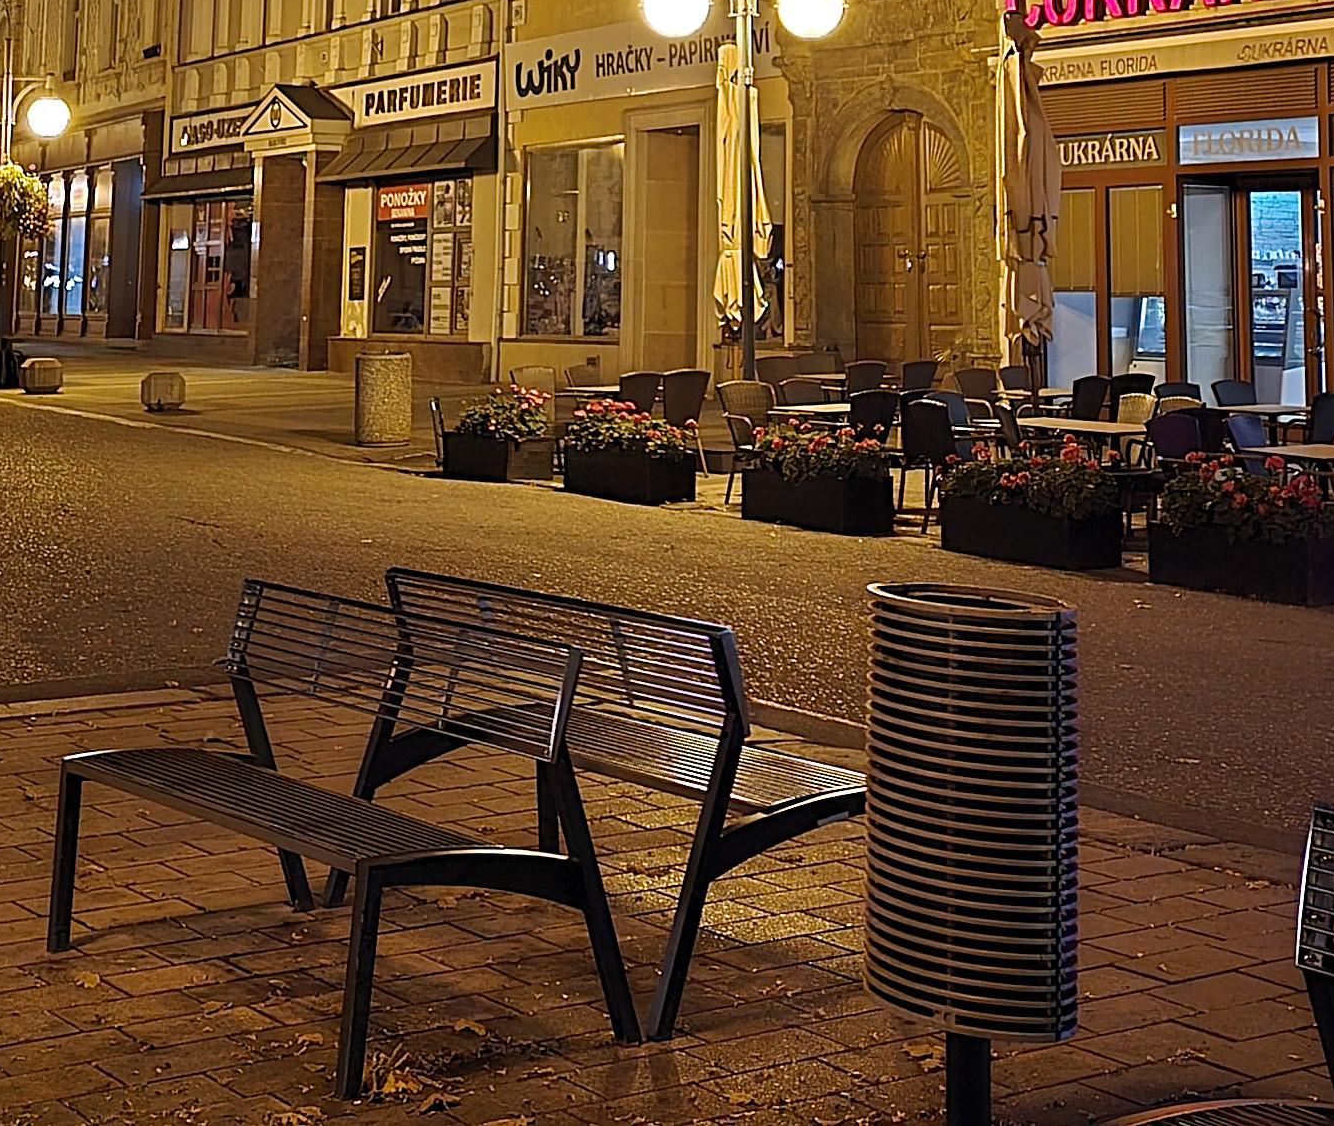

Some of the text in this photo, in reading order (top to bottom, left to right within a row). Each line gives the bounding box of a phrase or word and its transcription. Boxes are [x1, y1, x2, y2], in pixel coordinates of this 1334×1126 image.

[595, 45, 654, 78] HRAČKY
[1237, 35, 1329, 63] CUKRÁRNA
[1041, 54, 1158, 83] KRÁRNA FLORIDA
[364, 73, 482, 118] PARFUMERIE
[1058, 133, 1160, 166] UKRÁRNA
[1192, 124, 1303, 157] FLORIDA
[380, 187, 427, 209] PONOŽKY
